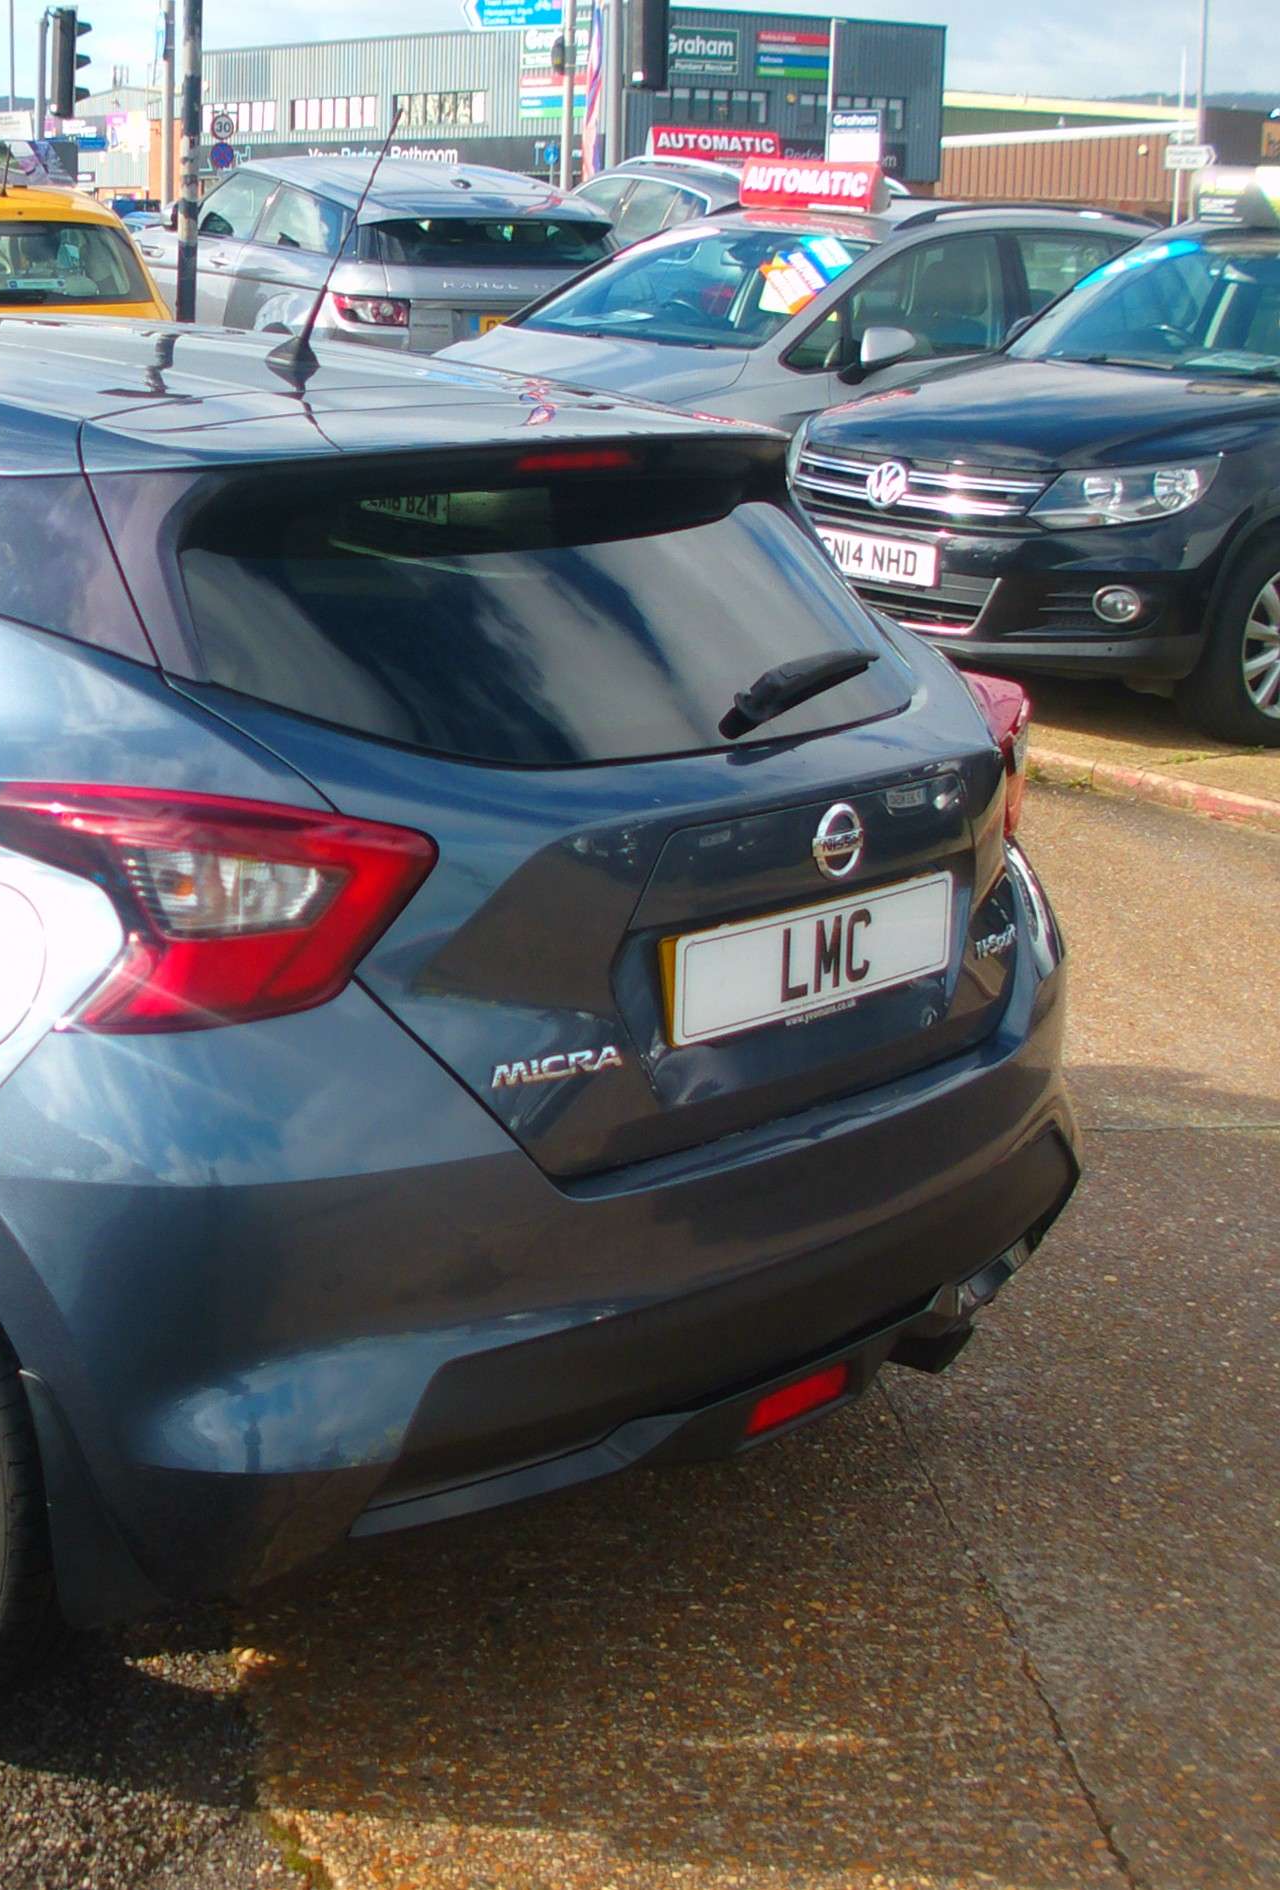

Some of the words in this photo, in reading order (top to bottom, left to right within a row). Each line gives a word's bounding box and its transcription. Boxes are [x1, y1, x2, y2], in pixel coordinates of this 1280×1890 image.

[669, 33, 734, 57] Graham
[215, 121, 231, 133] 30
[656, 132, 775, 154] AUTOMATIC
[743, 166, 869, 197] AUTOMATIC
[871, 543, 918, 577] NHD
[780, 907, 872, 1004] LMC
[491, 1045, 623, 1089] MICRA
